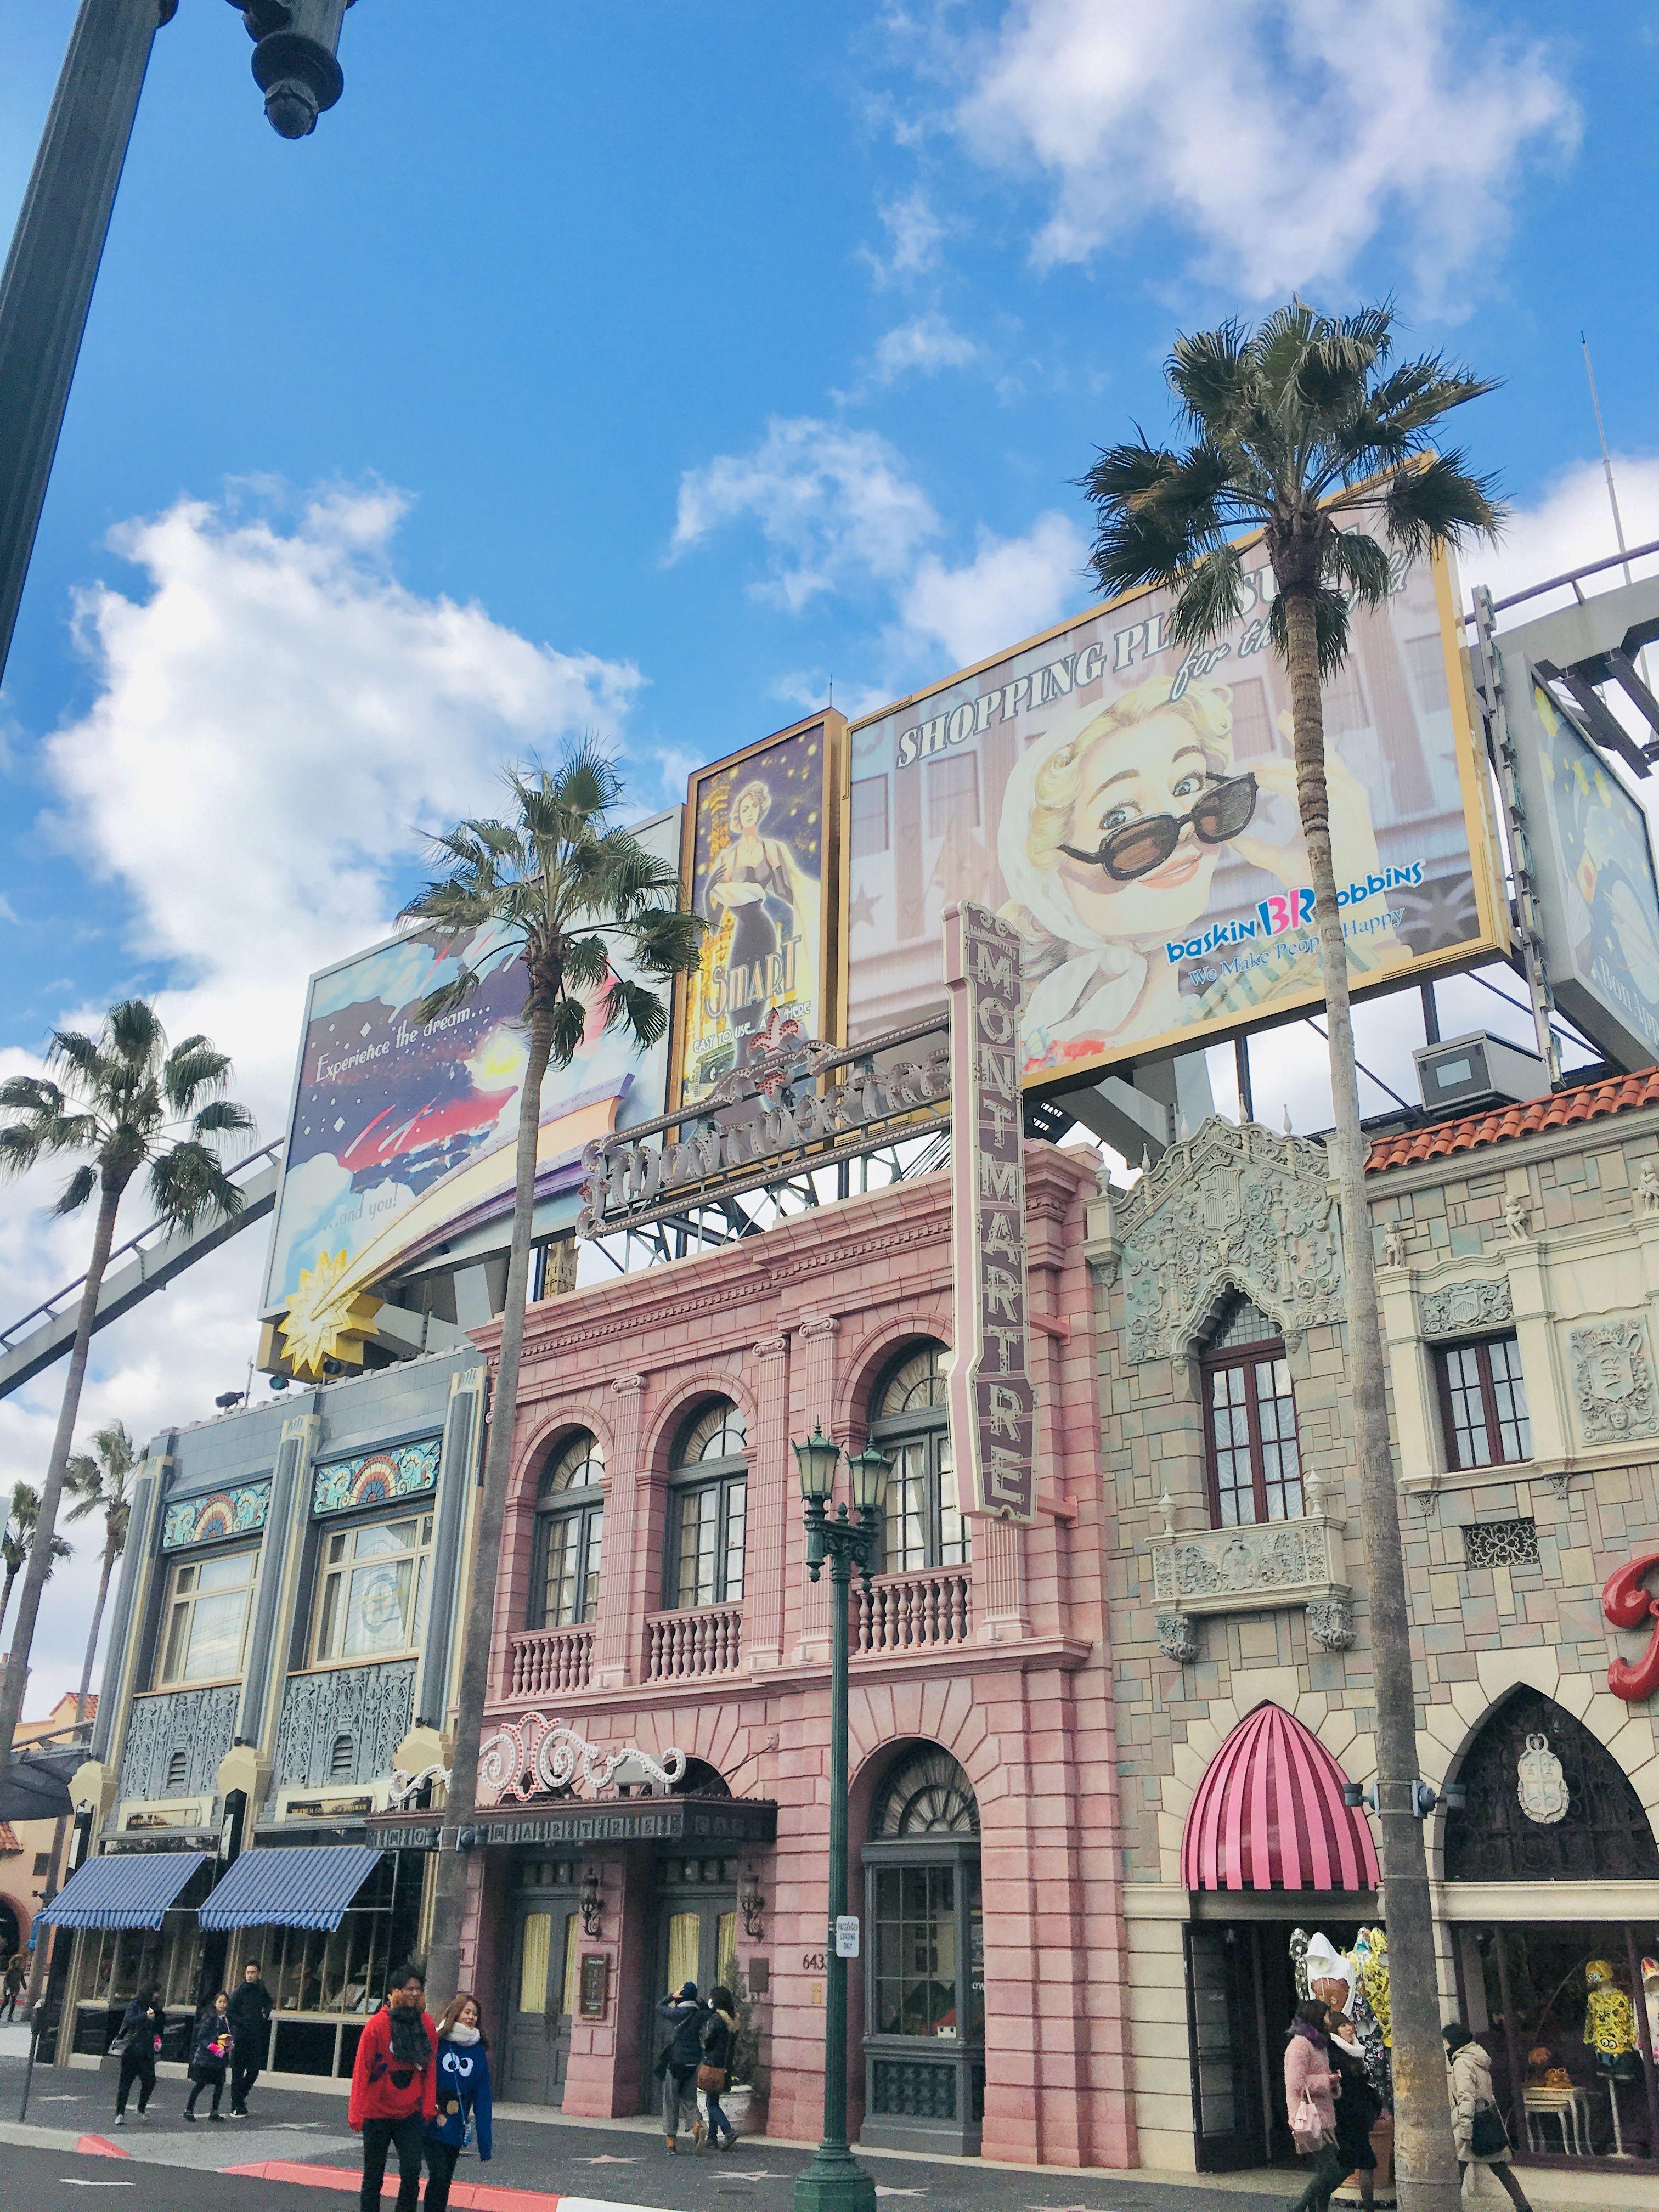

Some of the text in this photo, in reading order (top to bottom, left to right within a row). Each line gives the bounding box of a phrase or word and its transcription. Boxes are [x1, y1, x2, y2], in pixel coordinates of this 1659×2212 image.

[1170, 613, 1274, 703] for th
[896, 642, 1107, 768] SHOPPING
[1165, 859, 1425, 963] baskin BR obbins
[1189, 908, 1405, 987] We Make Peop Happy
[704, 934, 802, 1019] SMART
[316, 1006, 490, 1082] Experience the dream...
[693, 1034, 715, 1053] EASY
[718, 1029, 732, 1046] TO
[369, 1182, 398, 1221] you!
[977, 942, 1025, 1504] MONTMARTRE
